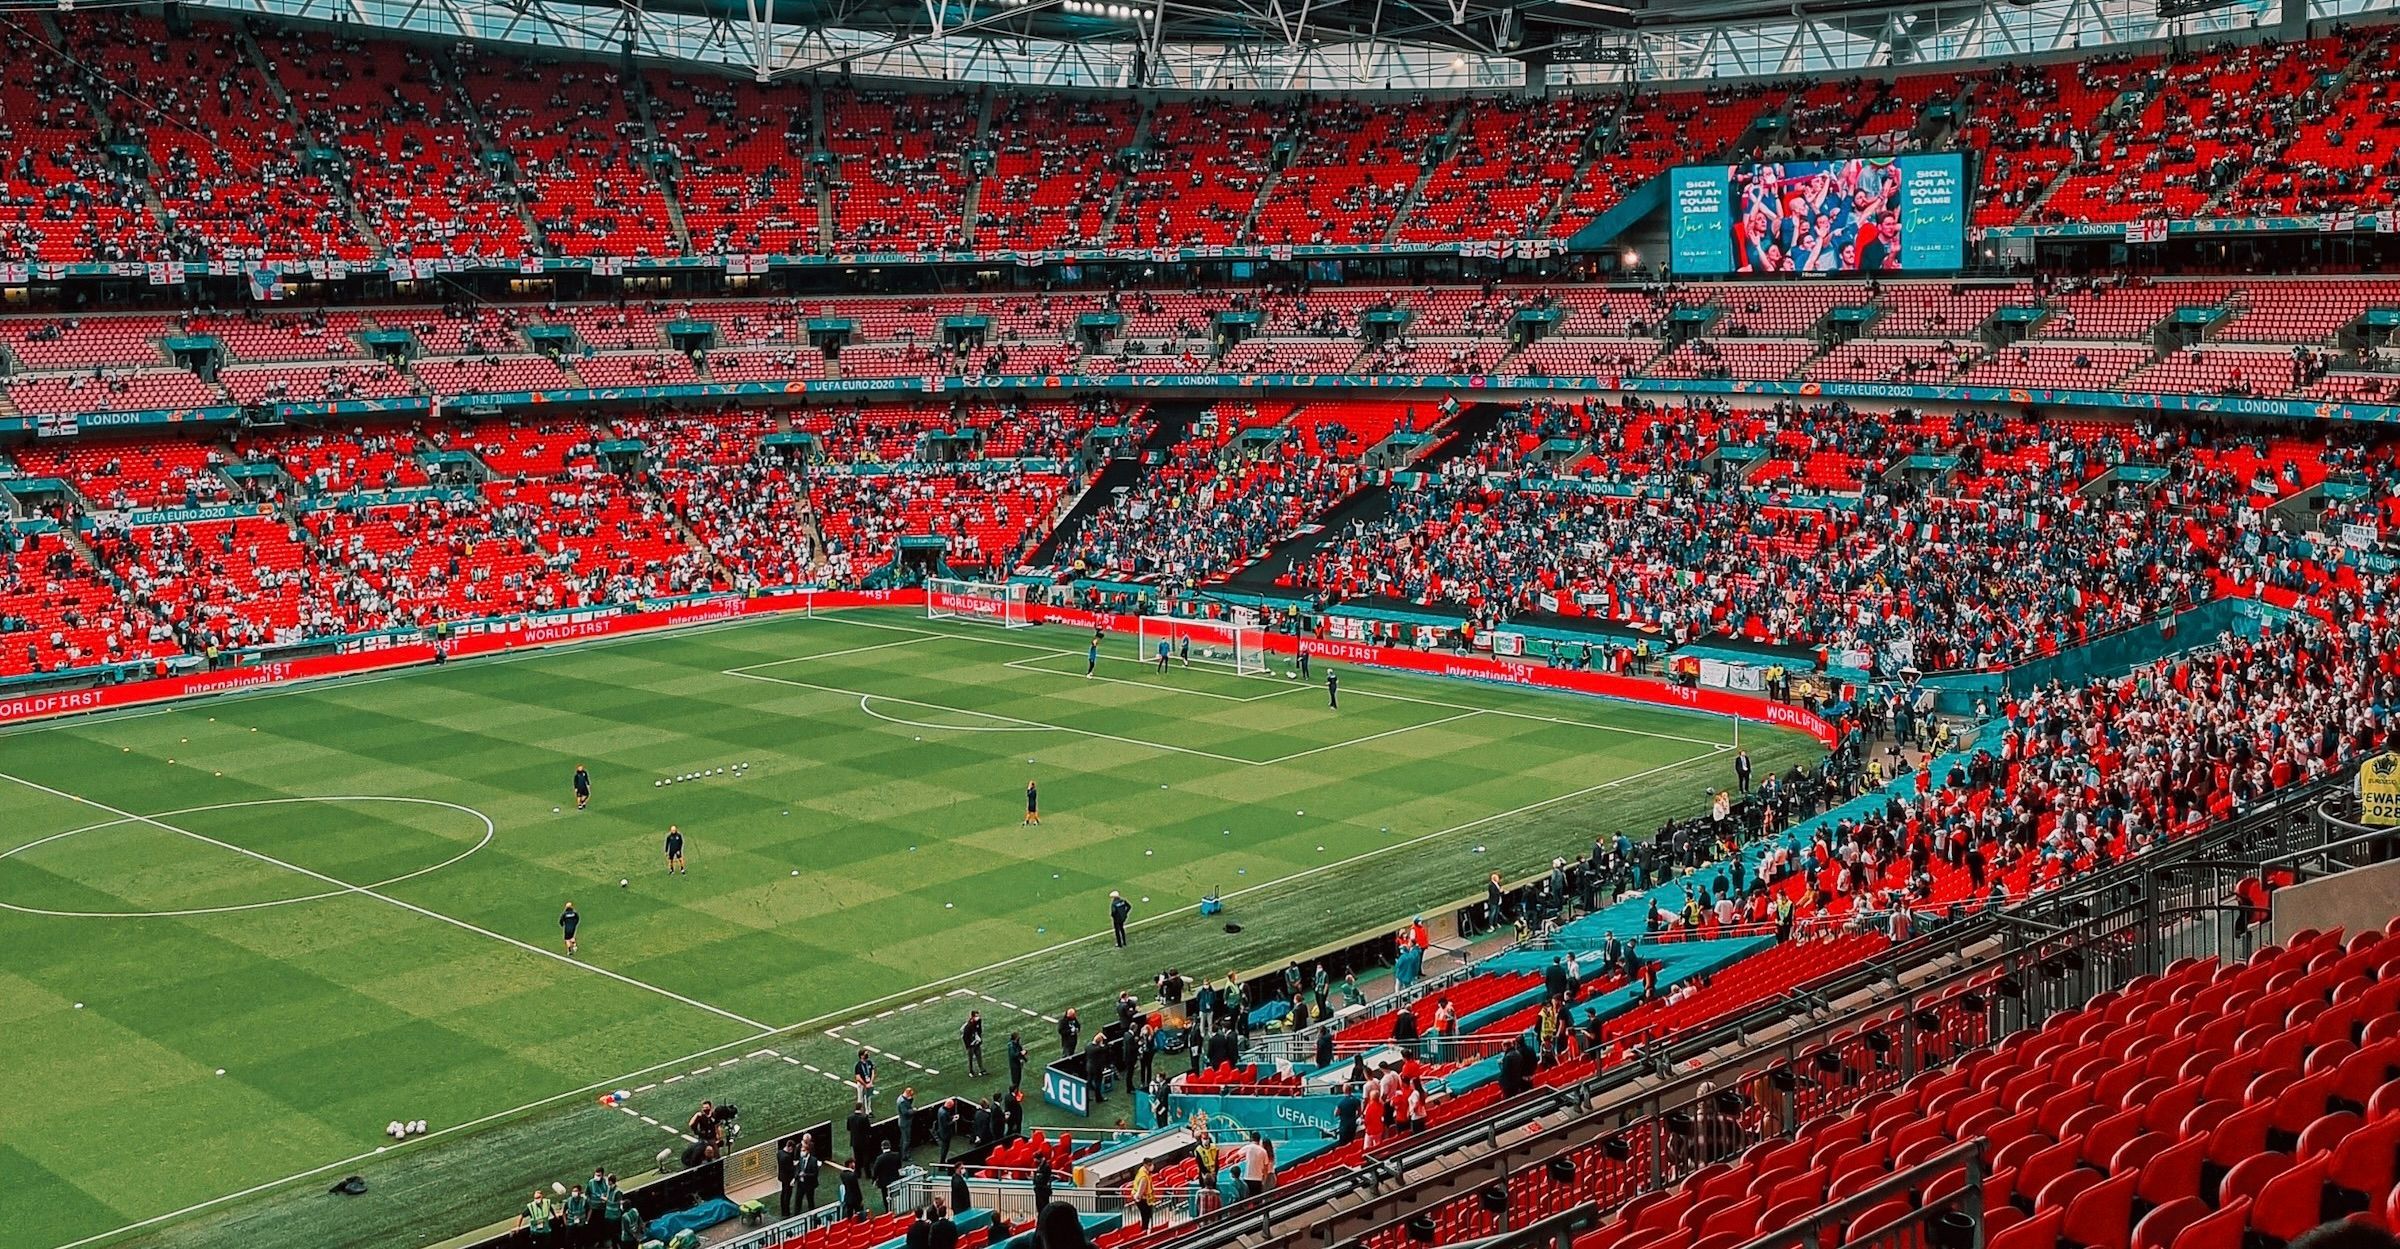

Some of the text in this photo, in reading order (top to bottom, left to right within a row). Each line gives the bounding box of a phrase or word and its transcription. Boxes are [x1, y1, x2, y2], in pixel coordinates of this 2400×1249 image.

[1916, 170, 1948, 178] SIGN
[1686, 181, 1716, 189] SIGN
[1908, 178, 1955, 187] FOR AN
[1679, 189, 1703, 197] FOR
[1910, 187, 1953, 197] EQUAL
[1680, 197, 1720, 206] EQUAL
[1912, 196, 1951, 205] GAME
[1683, 205, 1718, 213] GAME
[1941, 212, 1955, 223] us
[1709, 221, 1722, 230] us
[2077, 224, 2116, 235] LONDON
[814, 379, 895, 391] UEFA EURO 2020
[1177, 375, 1219, 386] LONDON
[1830, 383, 1914, 397] UEFA EURO 2020
[471, 393, 516, 405] THE FINAL
[2237, 399, 2288, 414] LONDON
[85, 412, 140, 426] LONDON
[136, 507, 226, 524] UEFA EURO 2020
[668, 610, 731, 625] International
[525, 620, 611, 642] WORLDFIRST
[1300, 640, 1380, 661] WORLDFIRST
[1445, 664, 1518, 682] International
[184, 672, 271, 695] International
[0, 691, 103, 717] ORLDFIRST
[1766, 704, 1827, 737] WORLDFIRST
[1276, 1104, 1307, 1127] UEFA
